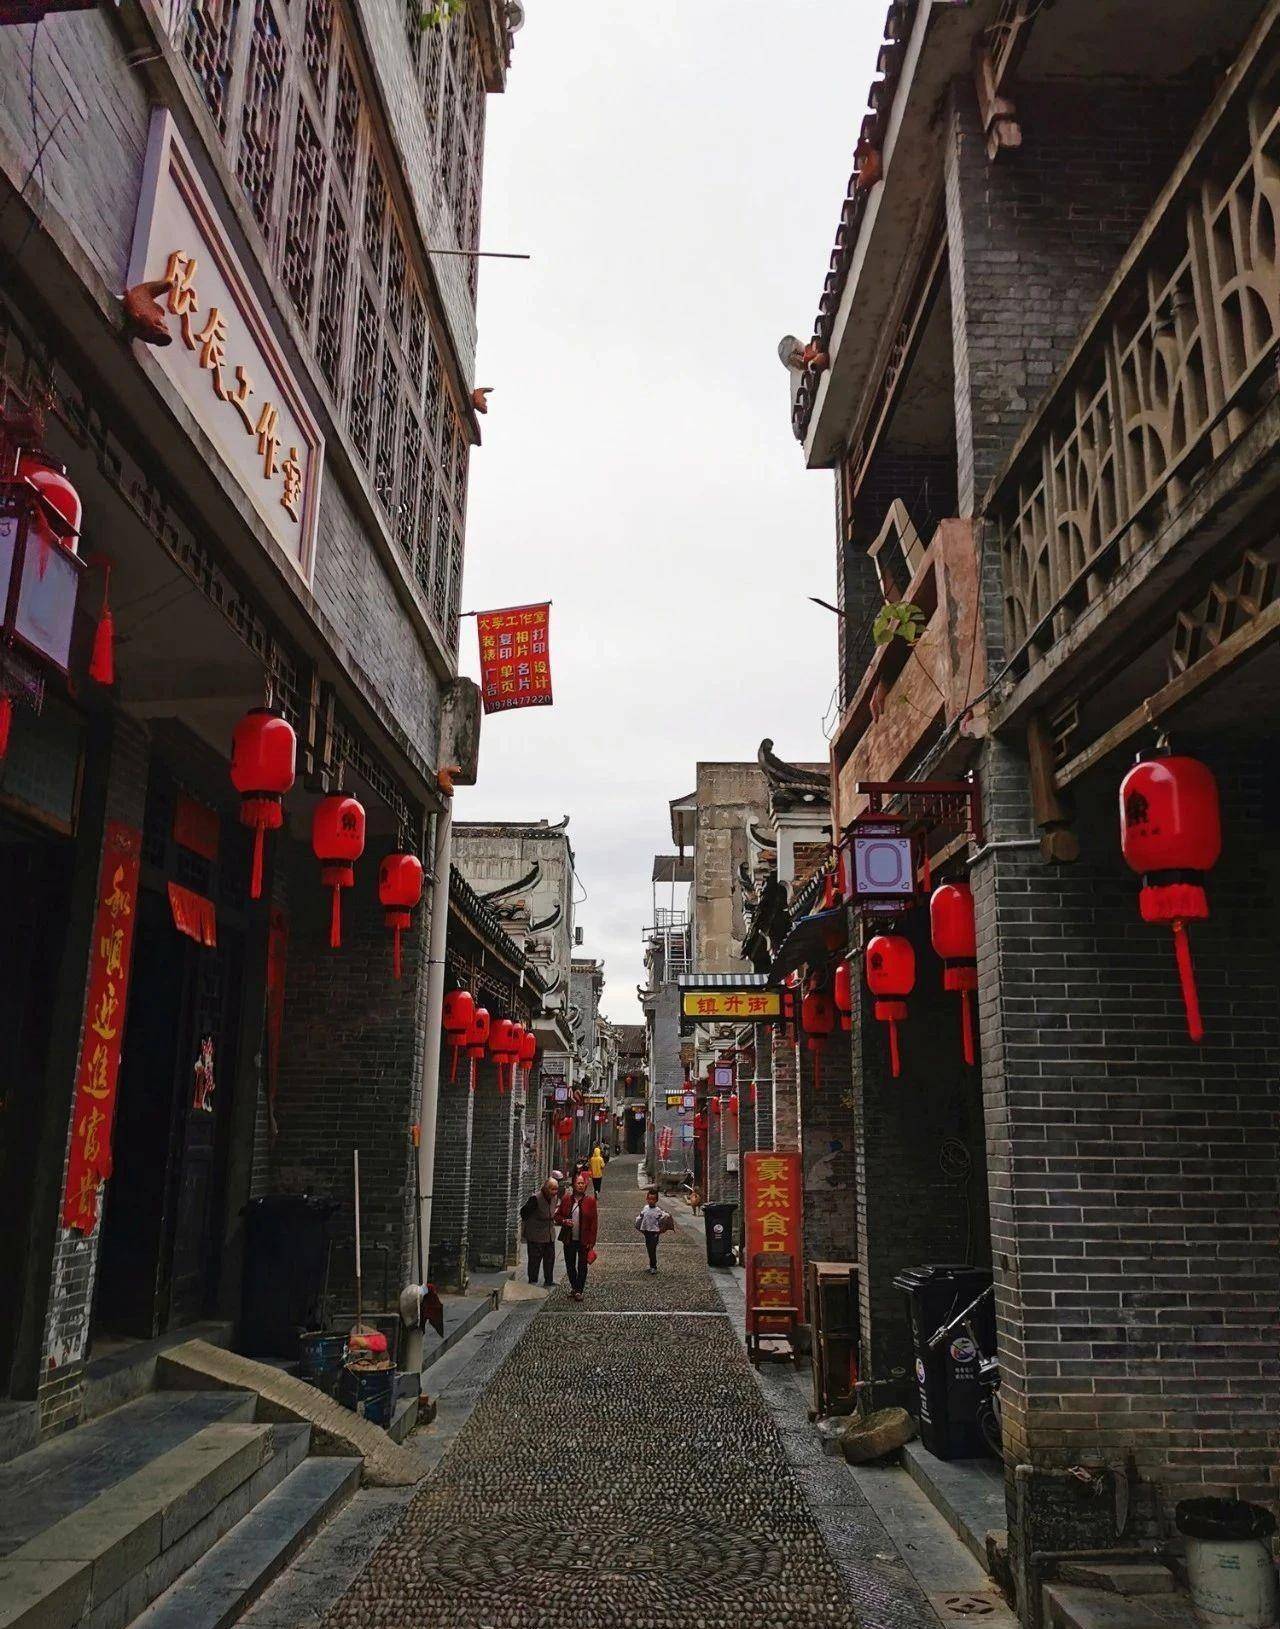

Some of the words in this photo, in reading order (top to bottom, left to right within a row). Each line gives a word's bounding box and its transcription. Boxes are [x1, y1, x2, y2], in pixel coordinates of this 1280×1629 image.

[499, 633, 513, 659] 复印
[515, 631, 529, 657] 相片
[533, 628, 546, 654] 打印
[501, 665, 515, 693] 单页
[518, 663, 531, 690] 名片
[534, 661, 548, 689] 设计
